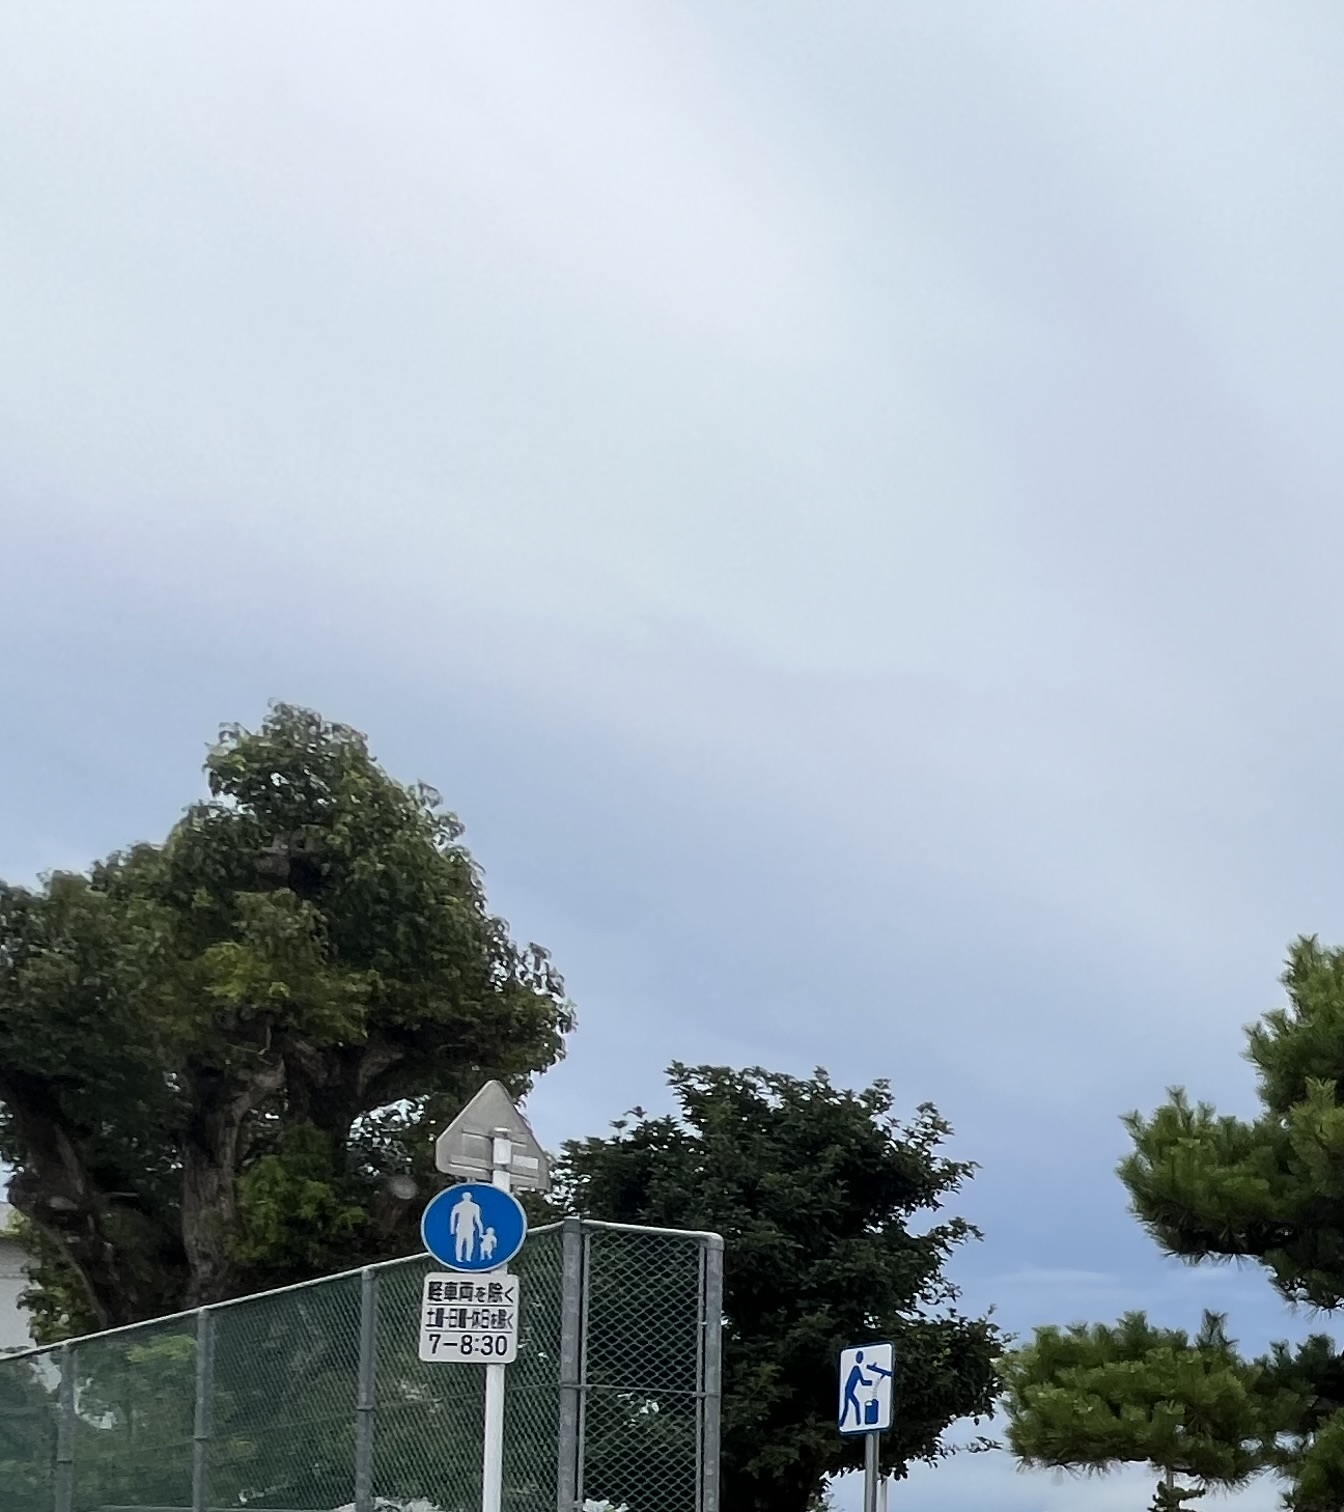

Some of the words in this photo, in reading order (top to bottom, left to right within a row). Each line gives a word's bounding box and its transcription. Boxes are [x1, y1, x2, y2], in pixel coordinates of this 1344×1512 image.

[427, 1281, 514, 1303] 軽車両を除く
